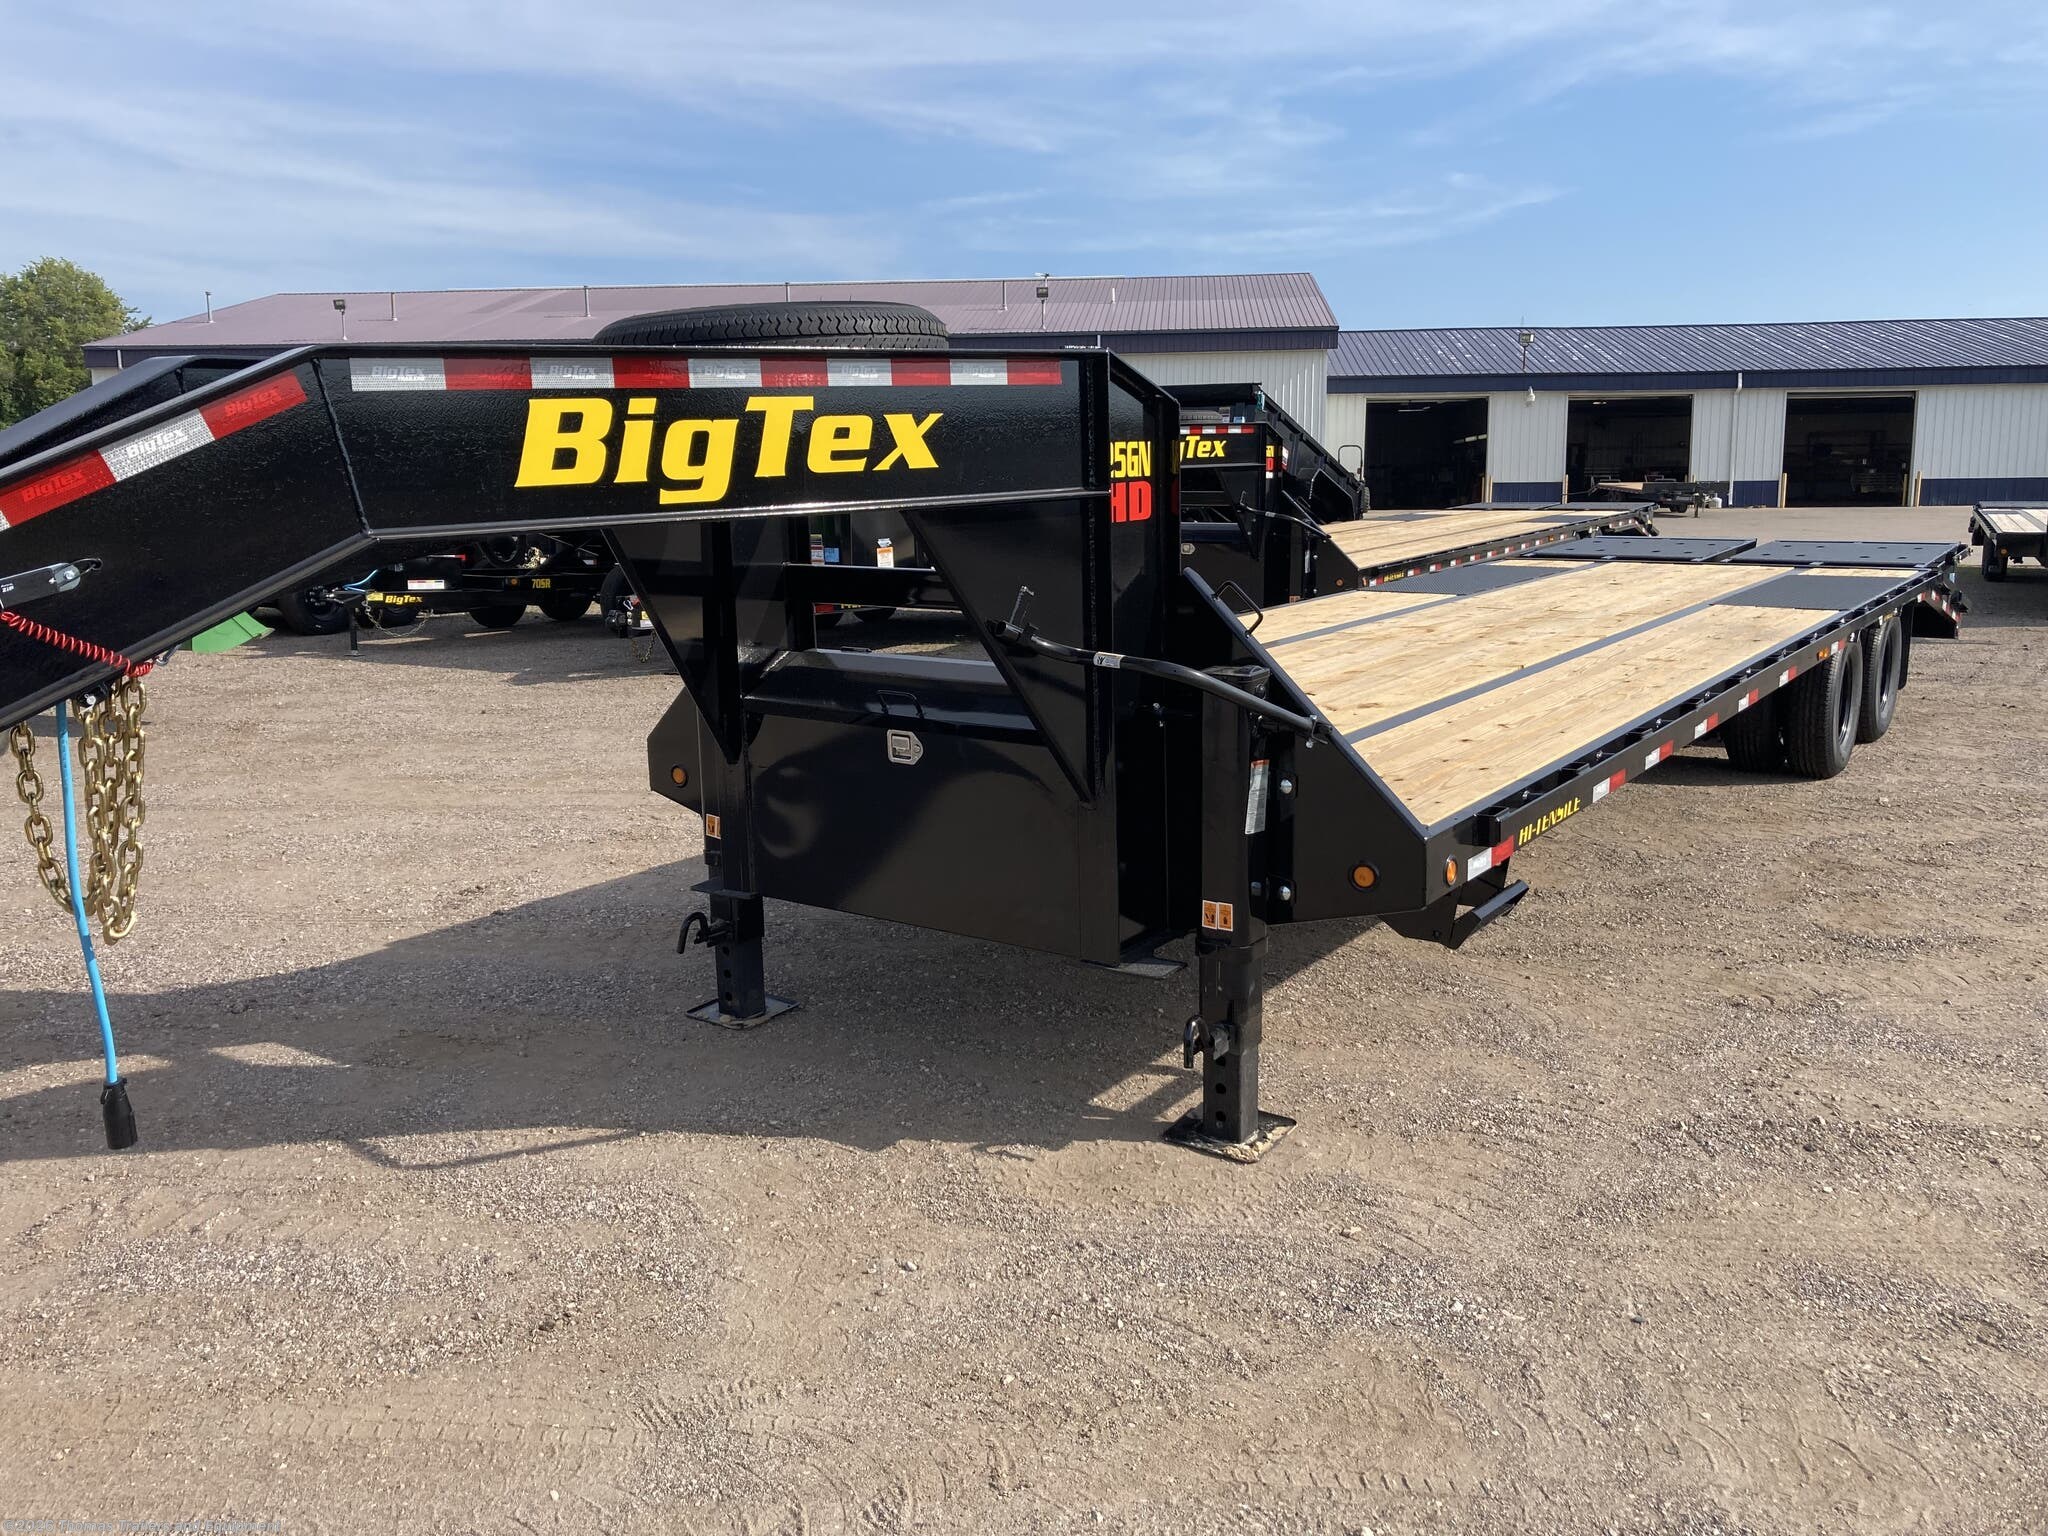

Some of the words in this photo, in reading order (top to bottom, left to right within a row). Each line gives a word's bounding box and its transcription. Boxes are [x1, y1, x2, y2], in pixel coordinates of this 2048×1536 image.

[371, 366, 423, 378] BigTex
[550, 365, 595, 377] BigTex
[126, 428, 185, 457] BigTex
[514, 396, 944, 504] BigTex
[1111, 481, 1152, 523] HD
[385, 595, 423, 605] BigTex
